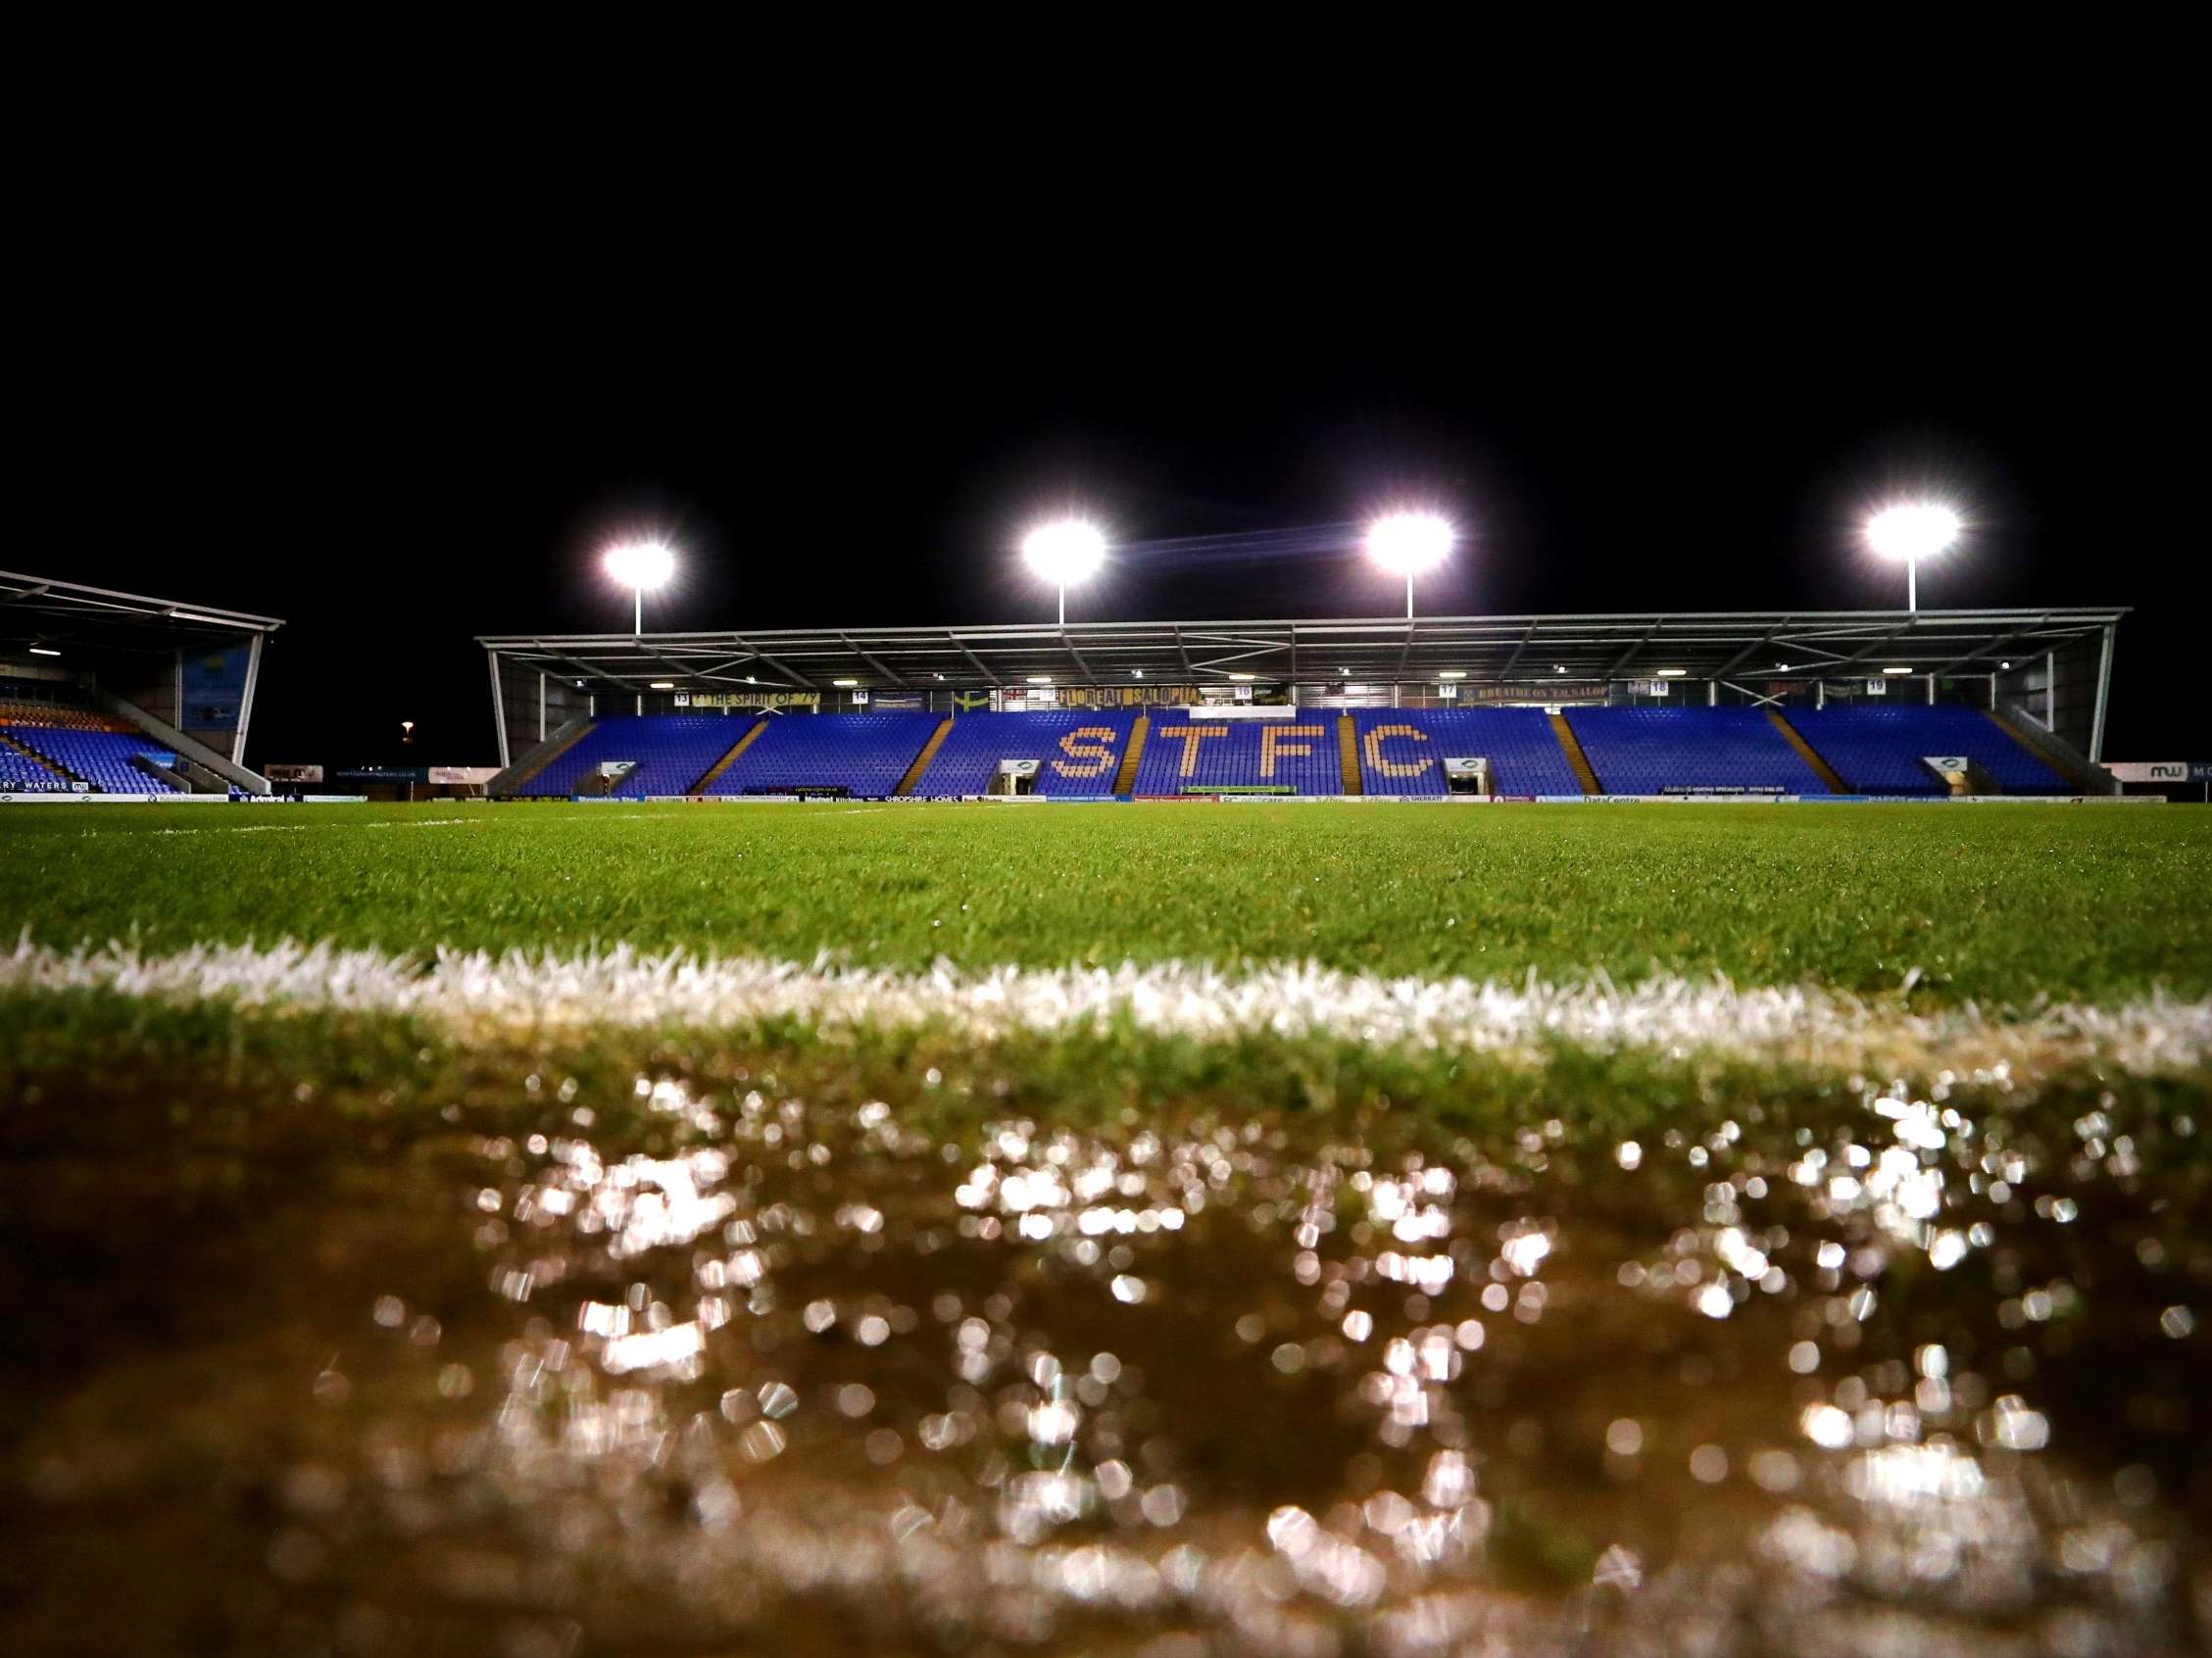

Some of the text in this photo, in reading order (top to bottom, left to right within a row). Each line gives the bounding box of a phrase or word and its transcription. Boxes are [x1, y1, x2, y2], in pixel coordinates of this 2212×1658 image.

[711, 693, 731, 705] THE
[735, 693, 770, 705] SPIRIT
[775, 693, 795, 704] OF
